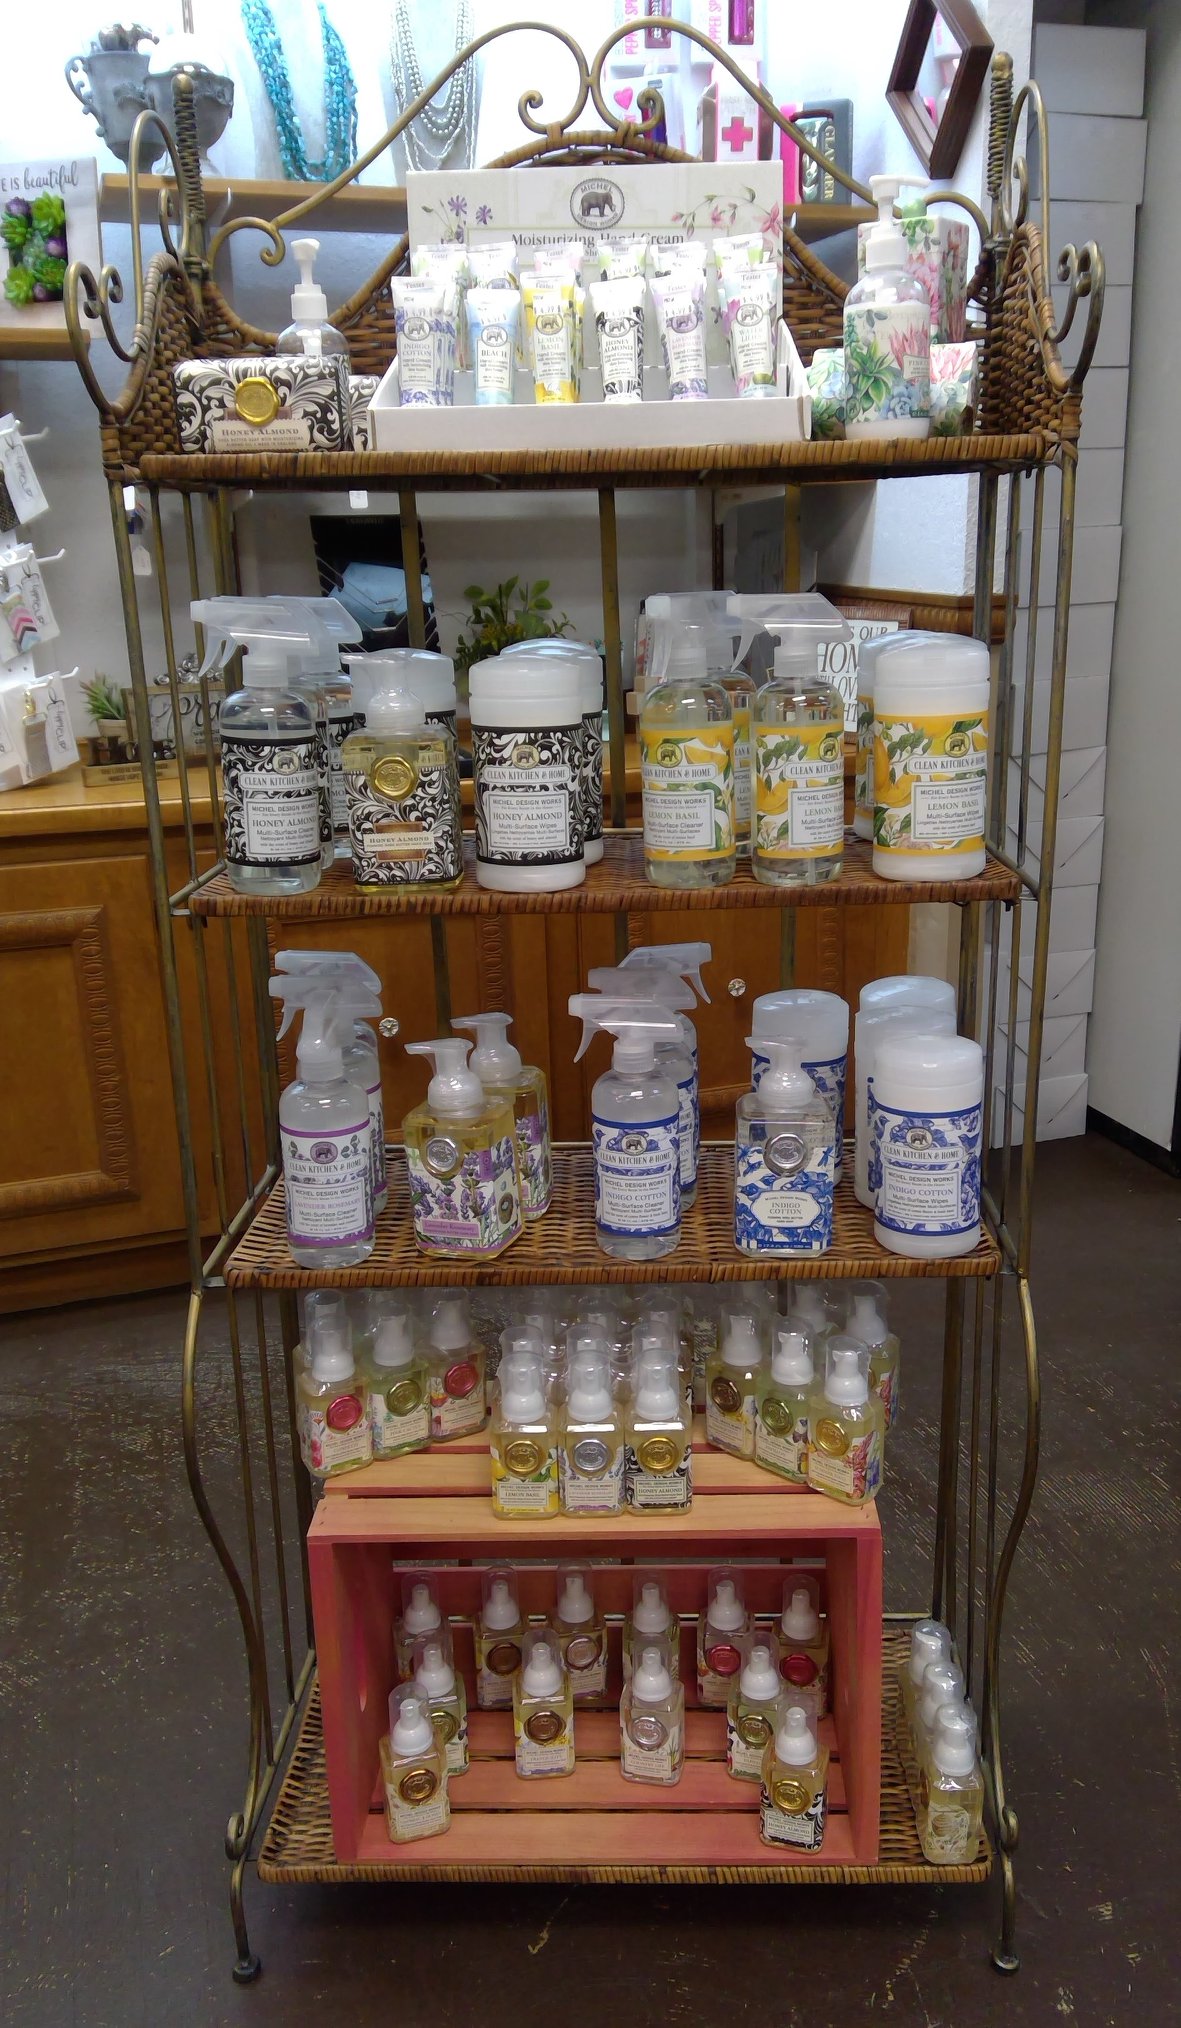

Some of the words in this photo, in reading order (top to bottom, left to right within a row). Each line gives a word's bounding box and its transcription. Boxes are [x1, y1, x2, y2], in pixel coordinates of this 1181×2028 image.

[10, 177, 20, 191] IS
[24, 161, 79, 194] beautiful
[580, 183, 613, 194] MICHEL
[511, 232, 595, 248] Moisturizing
[641, 232, 684, 245] Cream
[606, 339, 630, 347] HONEY
[481, 350, 508, 358] BEACH
[604, 345, 634, 353] ALMOND
[258, 427, 299, 435] ALMOND
[790, 766, 813, 775] CLEAN
[815, 763, 840, 774] KITCHEN
[914, 761, 938, 770] CLEAN
[940, 758, 969, 769] KITCHEN
[487, 771, 506, 779] CLEAN
[508, 771, 540, 780] KITCHEN
[548, 769, 566, 780] HOME
[654, 769, 681, 779] KITCHEN
[691, 768, 711, 778] HOME
[244, 776, 267, 784] CLEAN
[270, 776, 300, 786] KITCHEN
[946, 786, 969, 795] DESIGN
[252, 805, 276, 813] MICHEL
[927, 803, 959, 811] LEMON
[961, 799, 979, 809] BASIL
[493, 813, 523, 821] HONEY
[525, 812, 563, 821] ALMOND
[675, 811, 700, 820] BASIL
[804, 807, 832, 816] LEMON
[287, 816, 317, 827] ALMOND
[680, 821, 704, 829] Cleaner
[539, 823, 557, 831] Wipes
[883, 1145, 901, 1157] CLEAN
[902, 1149, 932, 1160] KITCHEN
[941, 1150, 960, 1160] HOME
[600, 1152, 617, 1162] CLEAN
[618, 1155, 647, 1165] KITCHEN
[655, 1152, 671, 1162] HOME
[289, 1162, 306, 1173] CLEAN
[308, 1163, 338, 1173] KITCHEN
[346, 1159, 362, 1170] HOME
[604, 1179, 624, 1188] MICHEL
[624, 1180, 647, 1188] DESIGN
[648, 1178, 667, 1188] WORKS
[295, 1189, 314, 1197] MICHEL
[316, 1188, 339, 1196] DESIGN
[340, 1185, 360, 1194] WORKS
[888, 1184, 917, 1195] INDIGO
[918, 1188, 954, 1196] COTTON
[605, 1191, 633, 1201] INDIGO
[634, 1191, 667, 1201] COTTON
[295, 1200, 326, 1210] LAVENDER
[644, 1200, 664, 1208] Cleaner
[336, 1208, 358, 1216] Cleaner
